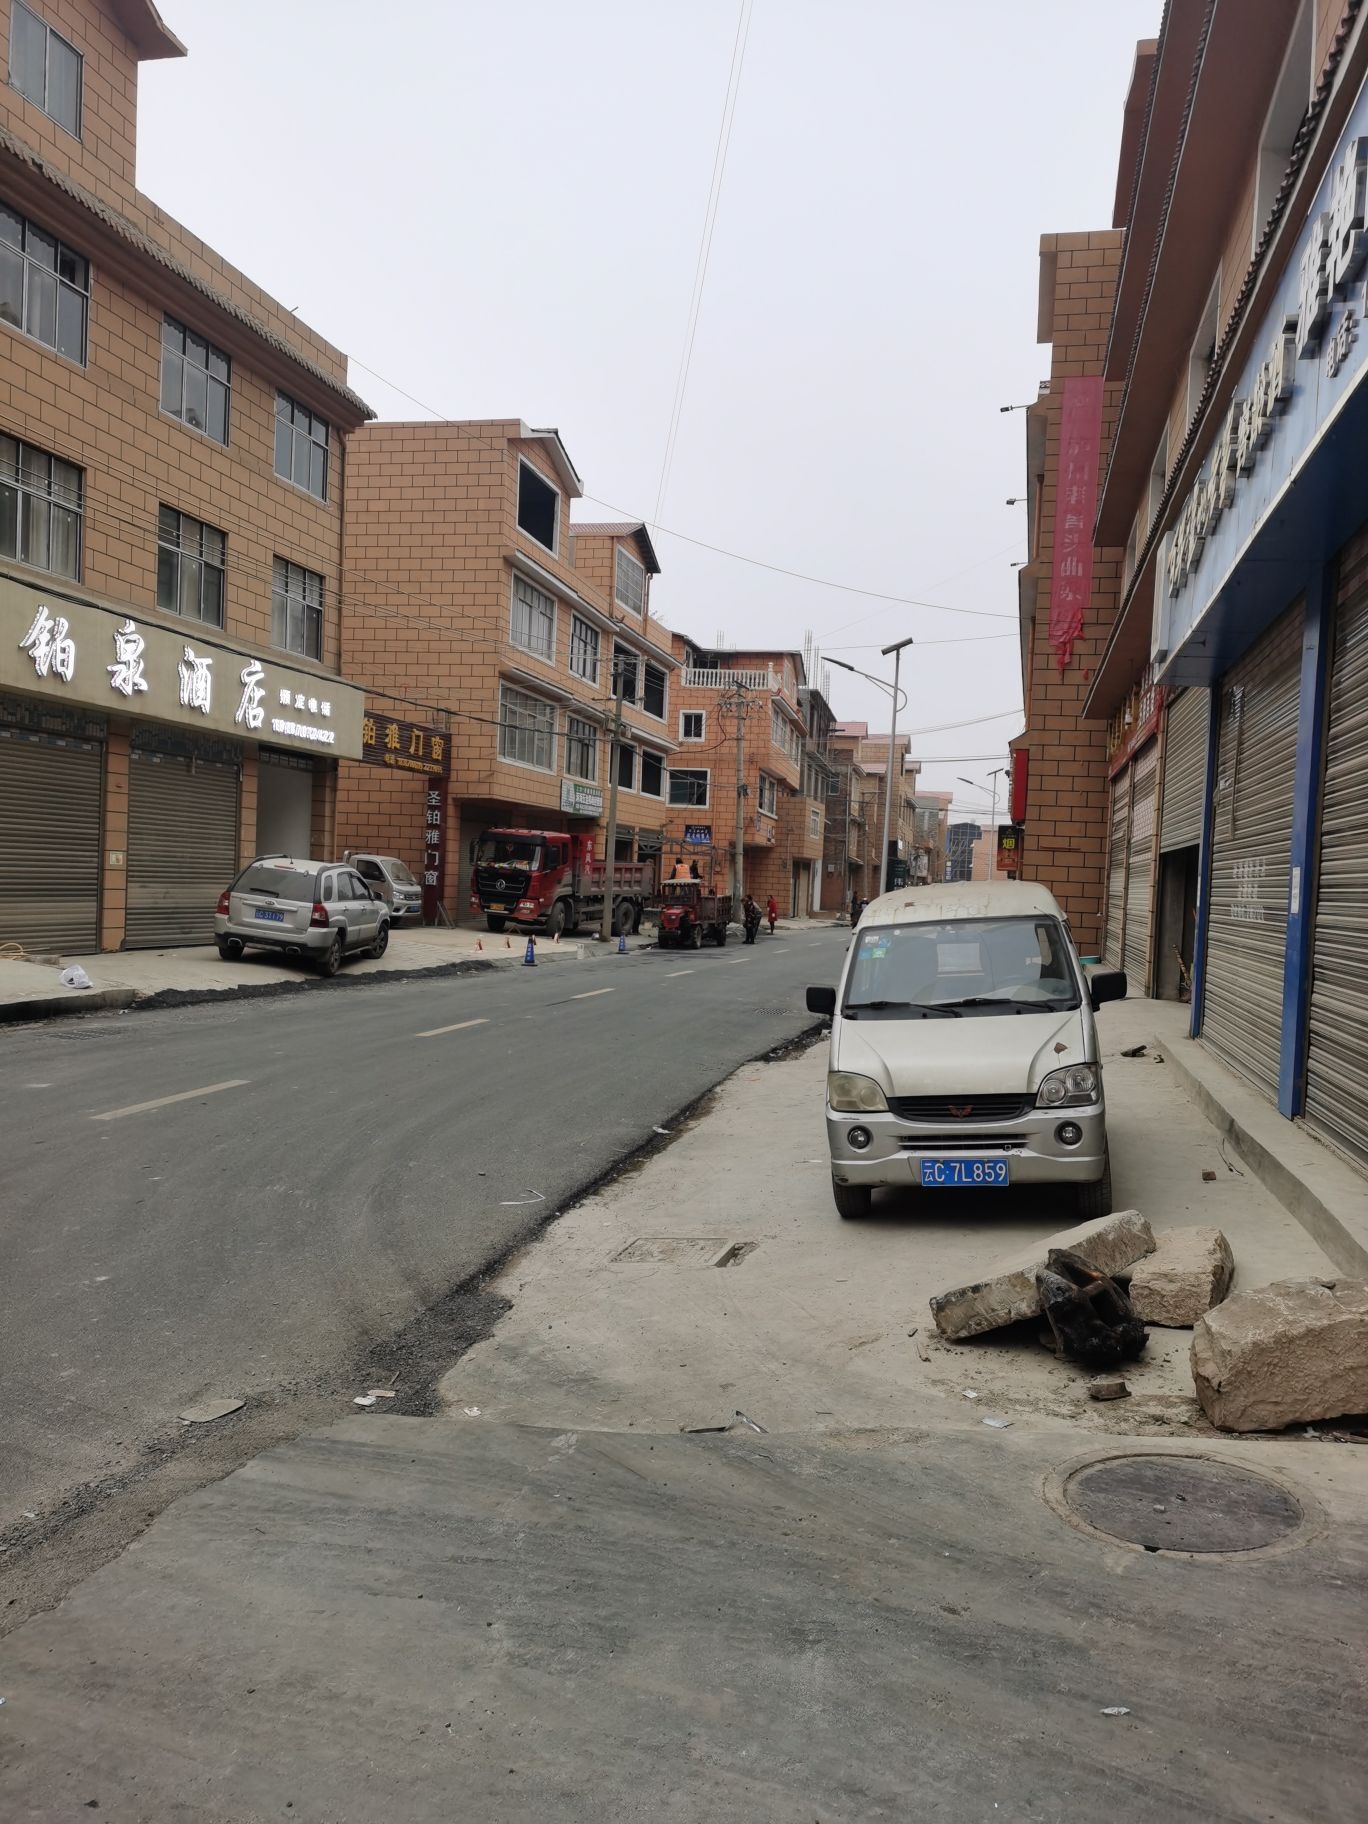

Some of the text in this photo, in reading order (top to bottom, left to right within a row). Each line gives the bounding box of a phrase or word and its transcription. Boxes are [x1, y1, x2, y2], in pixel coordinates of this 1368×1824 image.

[1296, 137, 1368, 360] 雅艳
[18, 604, 265, 729] 铂泉酒店
[424, 790, 442, 886] 圣铂雅门窗
[1002, 837, 1016, 849] 烟
